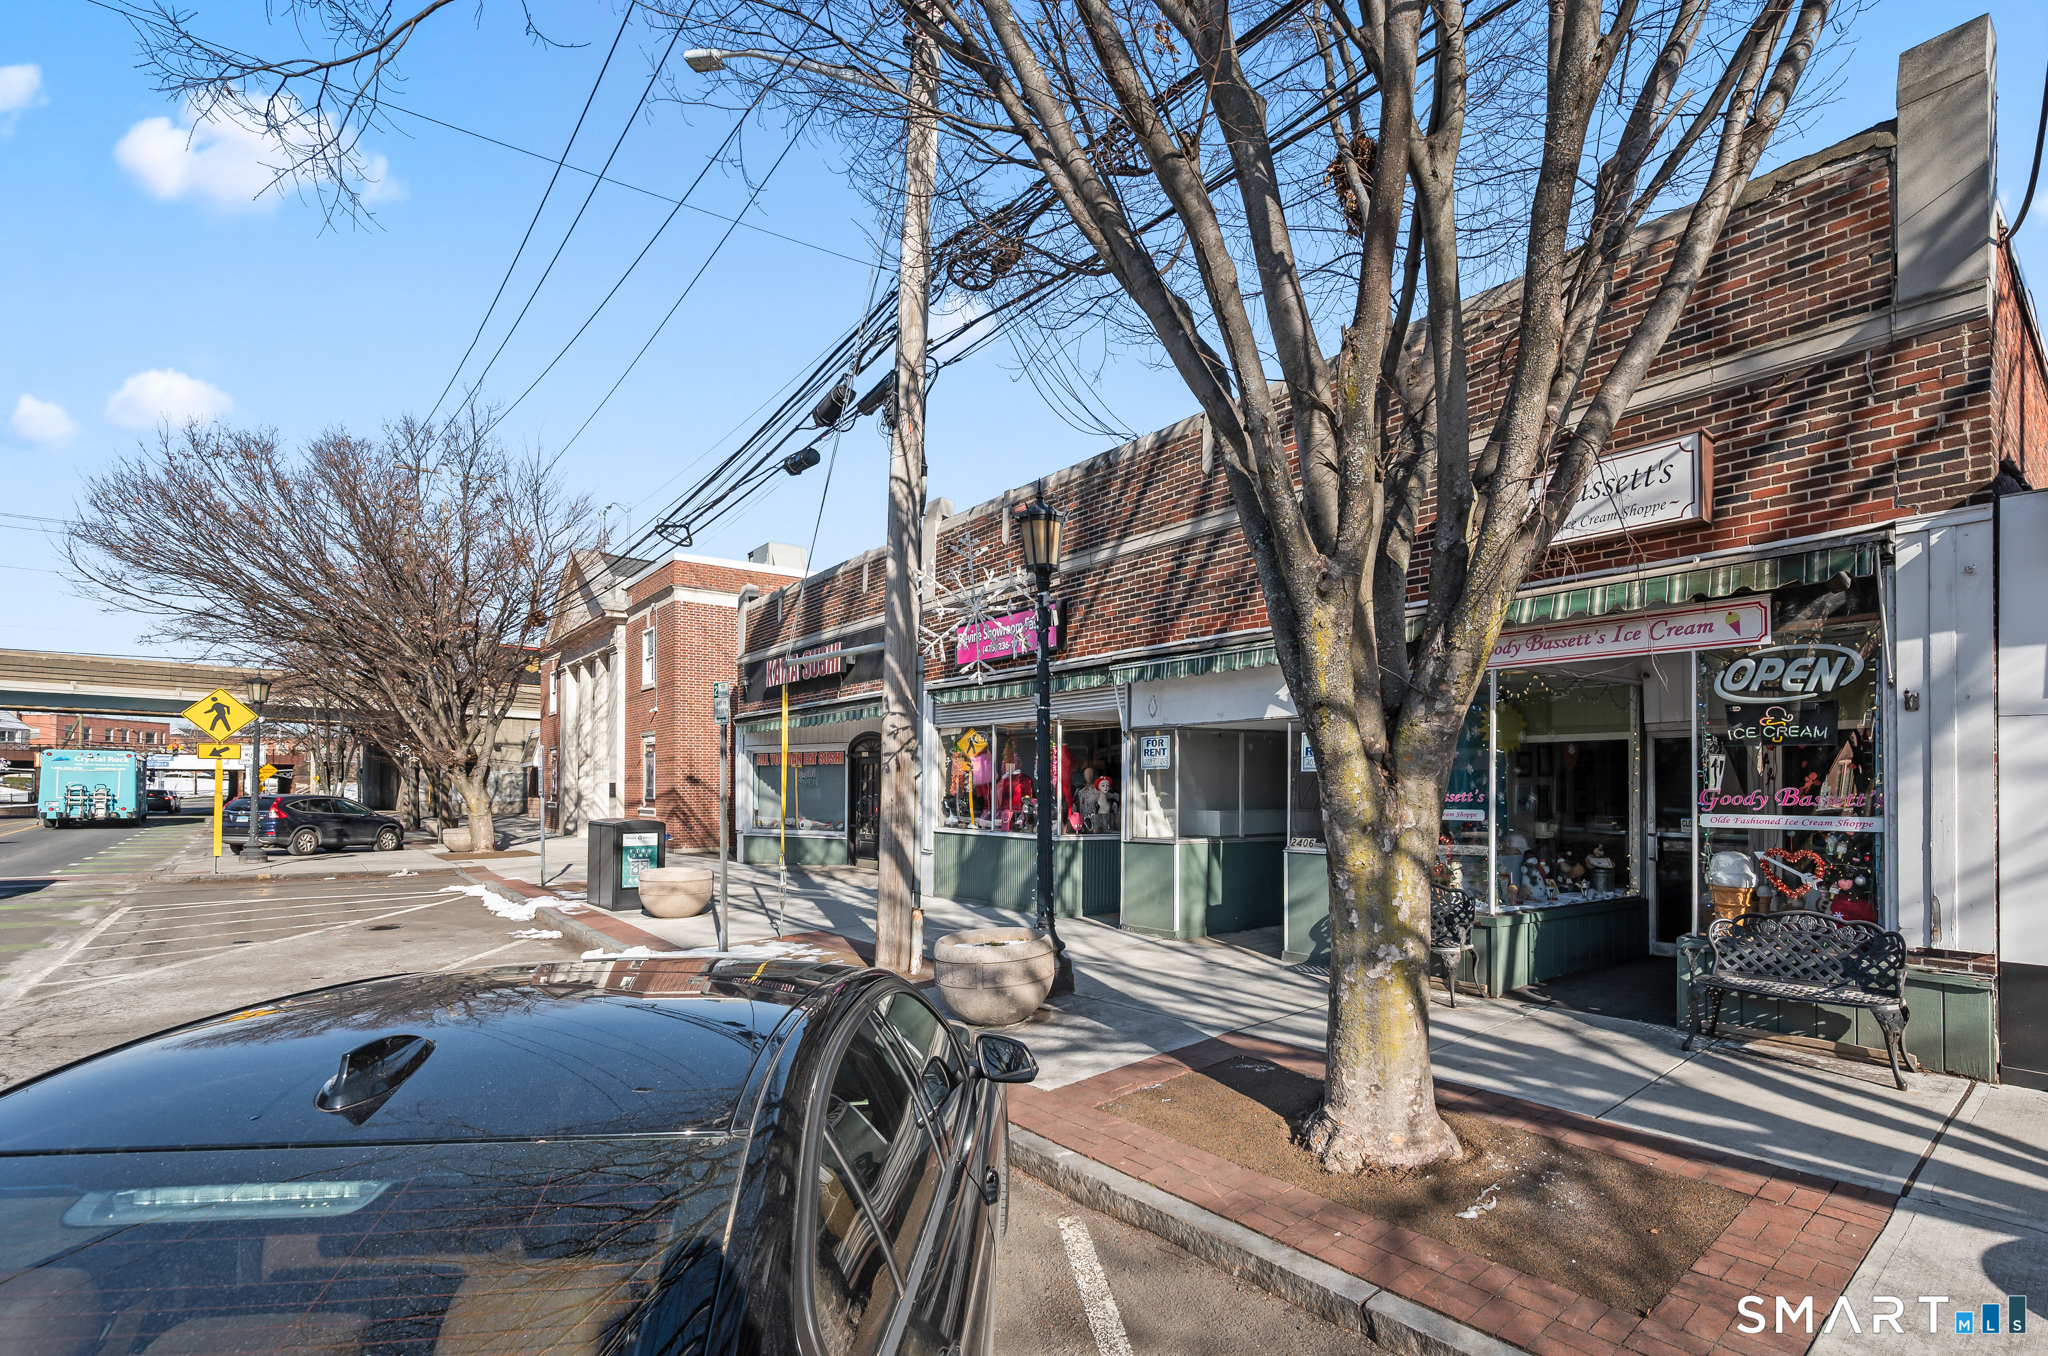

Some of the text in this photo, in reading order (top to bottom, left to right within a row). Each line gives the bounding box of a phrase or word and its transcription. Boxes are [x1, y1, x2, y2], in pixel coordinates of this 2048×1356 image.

[1577, 459, 1674, 503] ssett's
[1580, 511, 1617, 527] Cream
[1621, 500, 1667, 522] Shoppe
[1024, 616, 1039, 632] Fas
[1493, 620, 1714, 658] ody Bassett's Ice Cream
[802, 641, 842, 680] SUSHI
[1723, 656, 1847, 692] OPEN
[1727, 725, 1828, 740] ICE CREAM
[1146, 739, 1164, 748] FOR
[756, 751, 844, 766] ALL YO CAN EAT SUSHI
[1143, 748, 1167, 757] RENT
[1445, 789, 1485, 803] ssett's
[1699, 787, 1884, 812] Goody Bassett's
[1455, 811, 1477, 819] Shoppe
[1681, 819, 1693, 828] CLO
[1710, 816, 1875, 830] Olde Fashioned Ice Cream Shoppe
[1290, 838, 1315, 848] 2406
